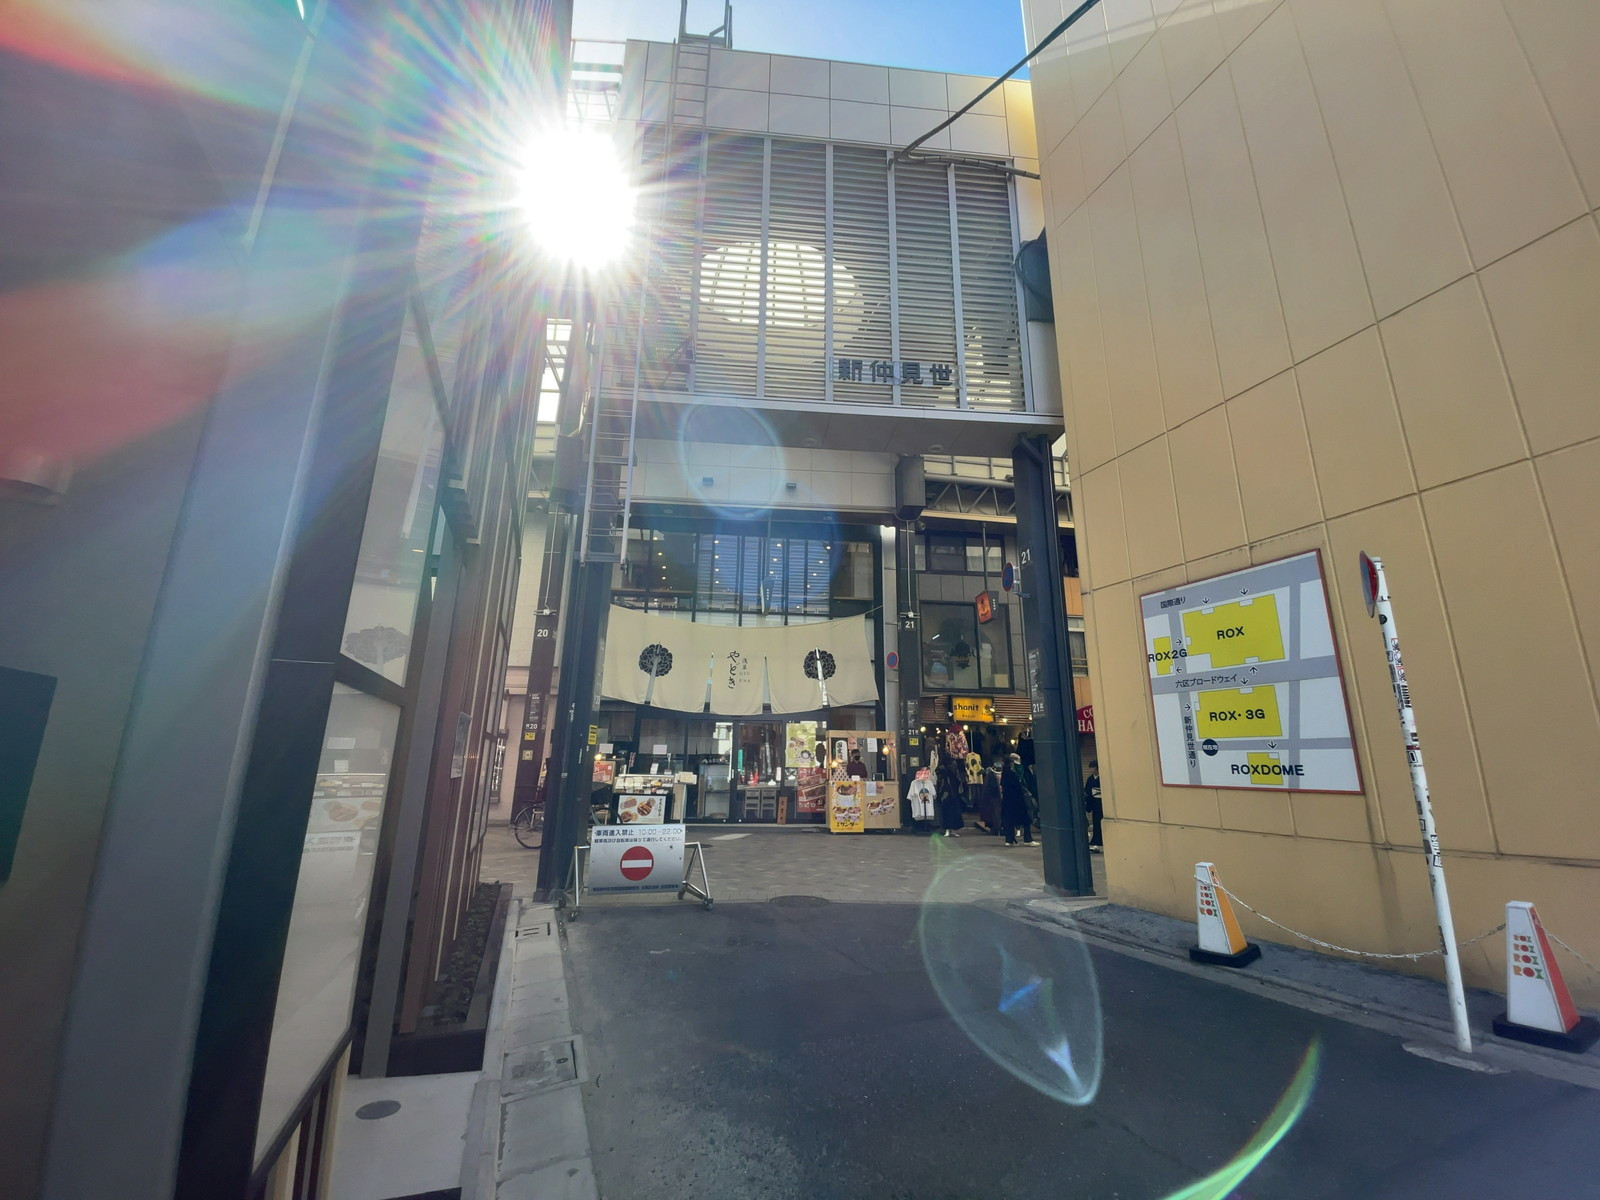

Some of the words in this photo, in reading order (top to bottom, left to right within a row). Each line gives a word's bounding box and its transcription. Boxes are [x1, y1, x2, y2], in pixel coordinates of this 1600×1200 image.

[838, 358, 953, 386] 新仲見世
[1021, 549, 1031, 565] 21
[1160, 596, 1186, 609] 国際通り
[905, 621, 915, 629] 21
[537, 629, 548, 637] 20
[1216, 626, 1245, 640] ROX
[1147, 648, 1188, 663] ROX2G
[1175, 674, 1237, 688] 六区ブロードウェイ
[1184, 716, 1196, 767] 新仲見世通り
[1231, 764, 1305, 776] ROXDOME
[1199, 907, 1218, 917] ROX
[1513, 953, 1539, 966] ROX
[1513, 965, 1544, 979] ROX
